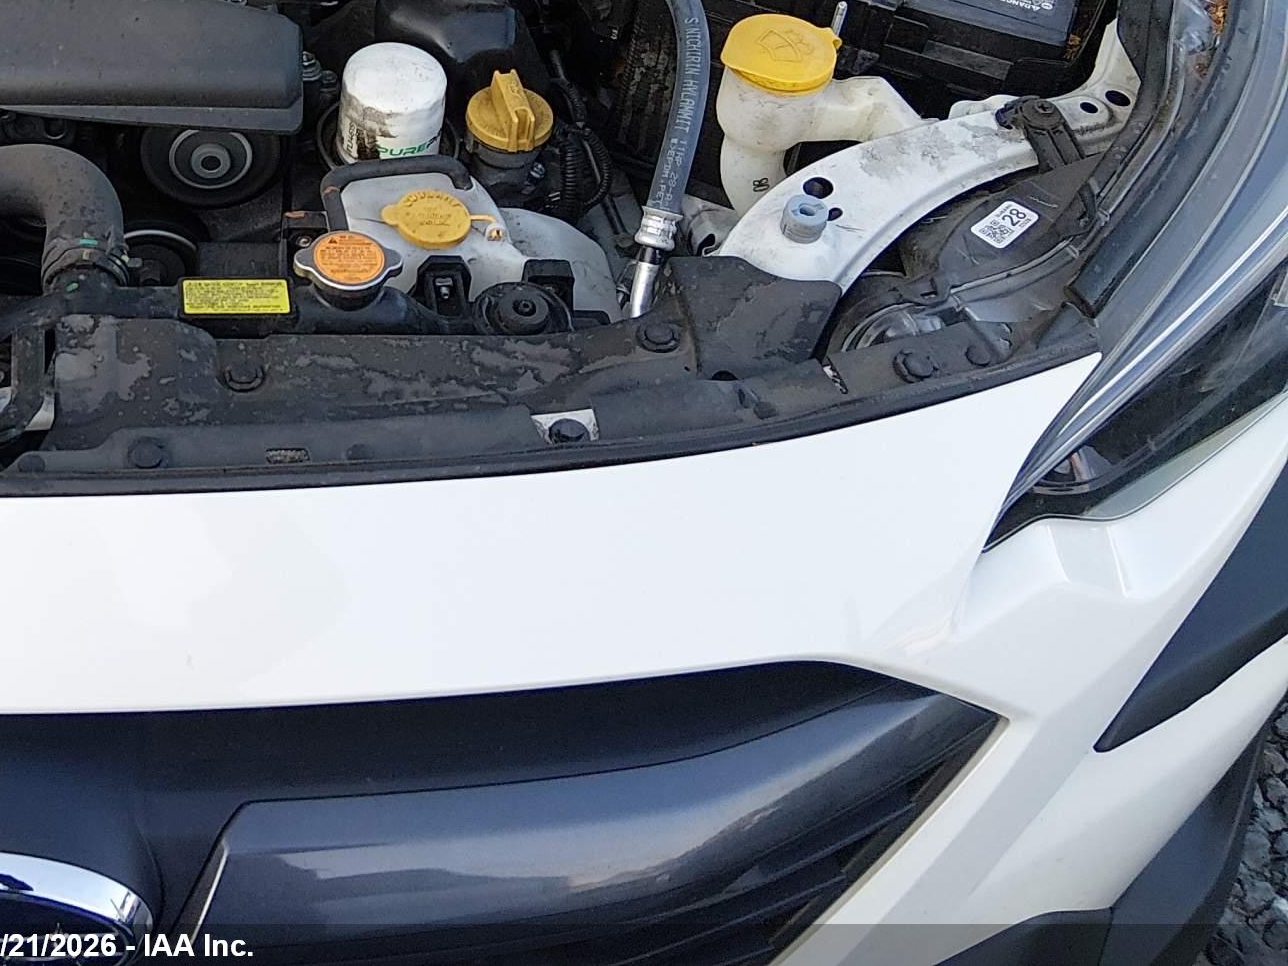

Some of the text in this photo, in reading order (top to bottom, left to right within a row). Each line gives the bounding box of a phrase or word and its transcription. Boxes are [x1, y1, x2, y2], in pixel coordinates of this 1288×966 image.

[684, 27, 702, 76] NICHIRIN
[674, 79, 699, 133] HYLAMMIT
[1002, 208, 1027, 227] 28
